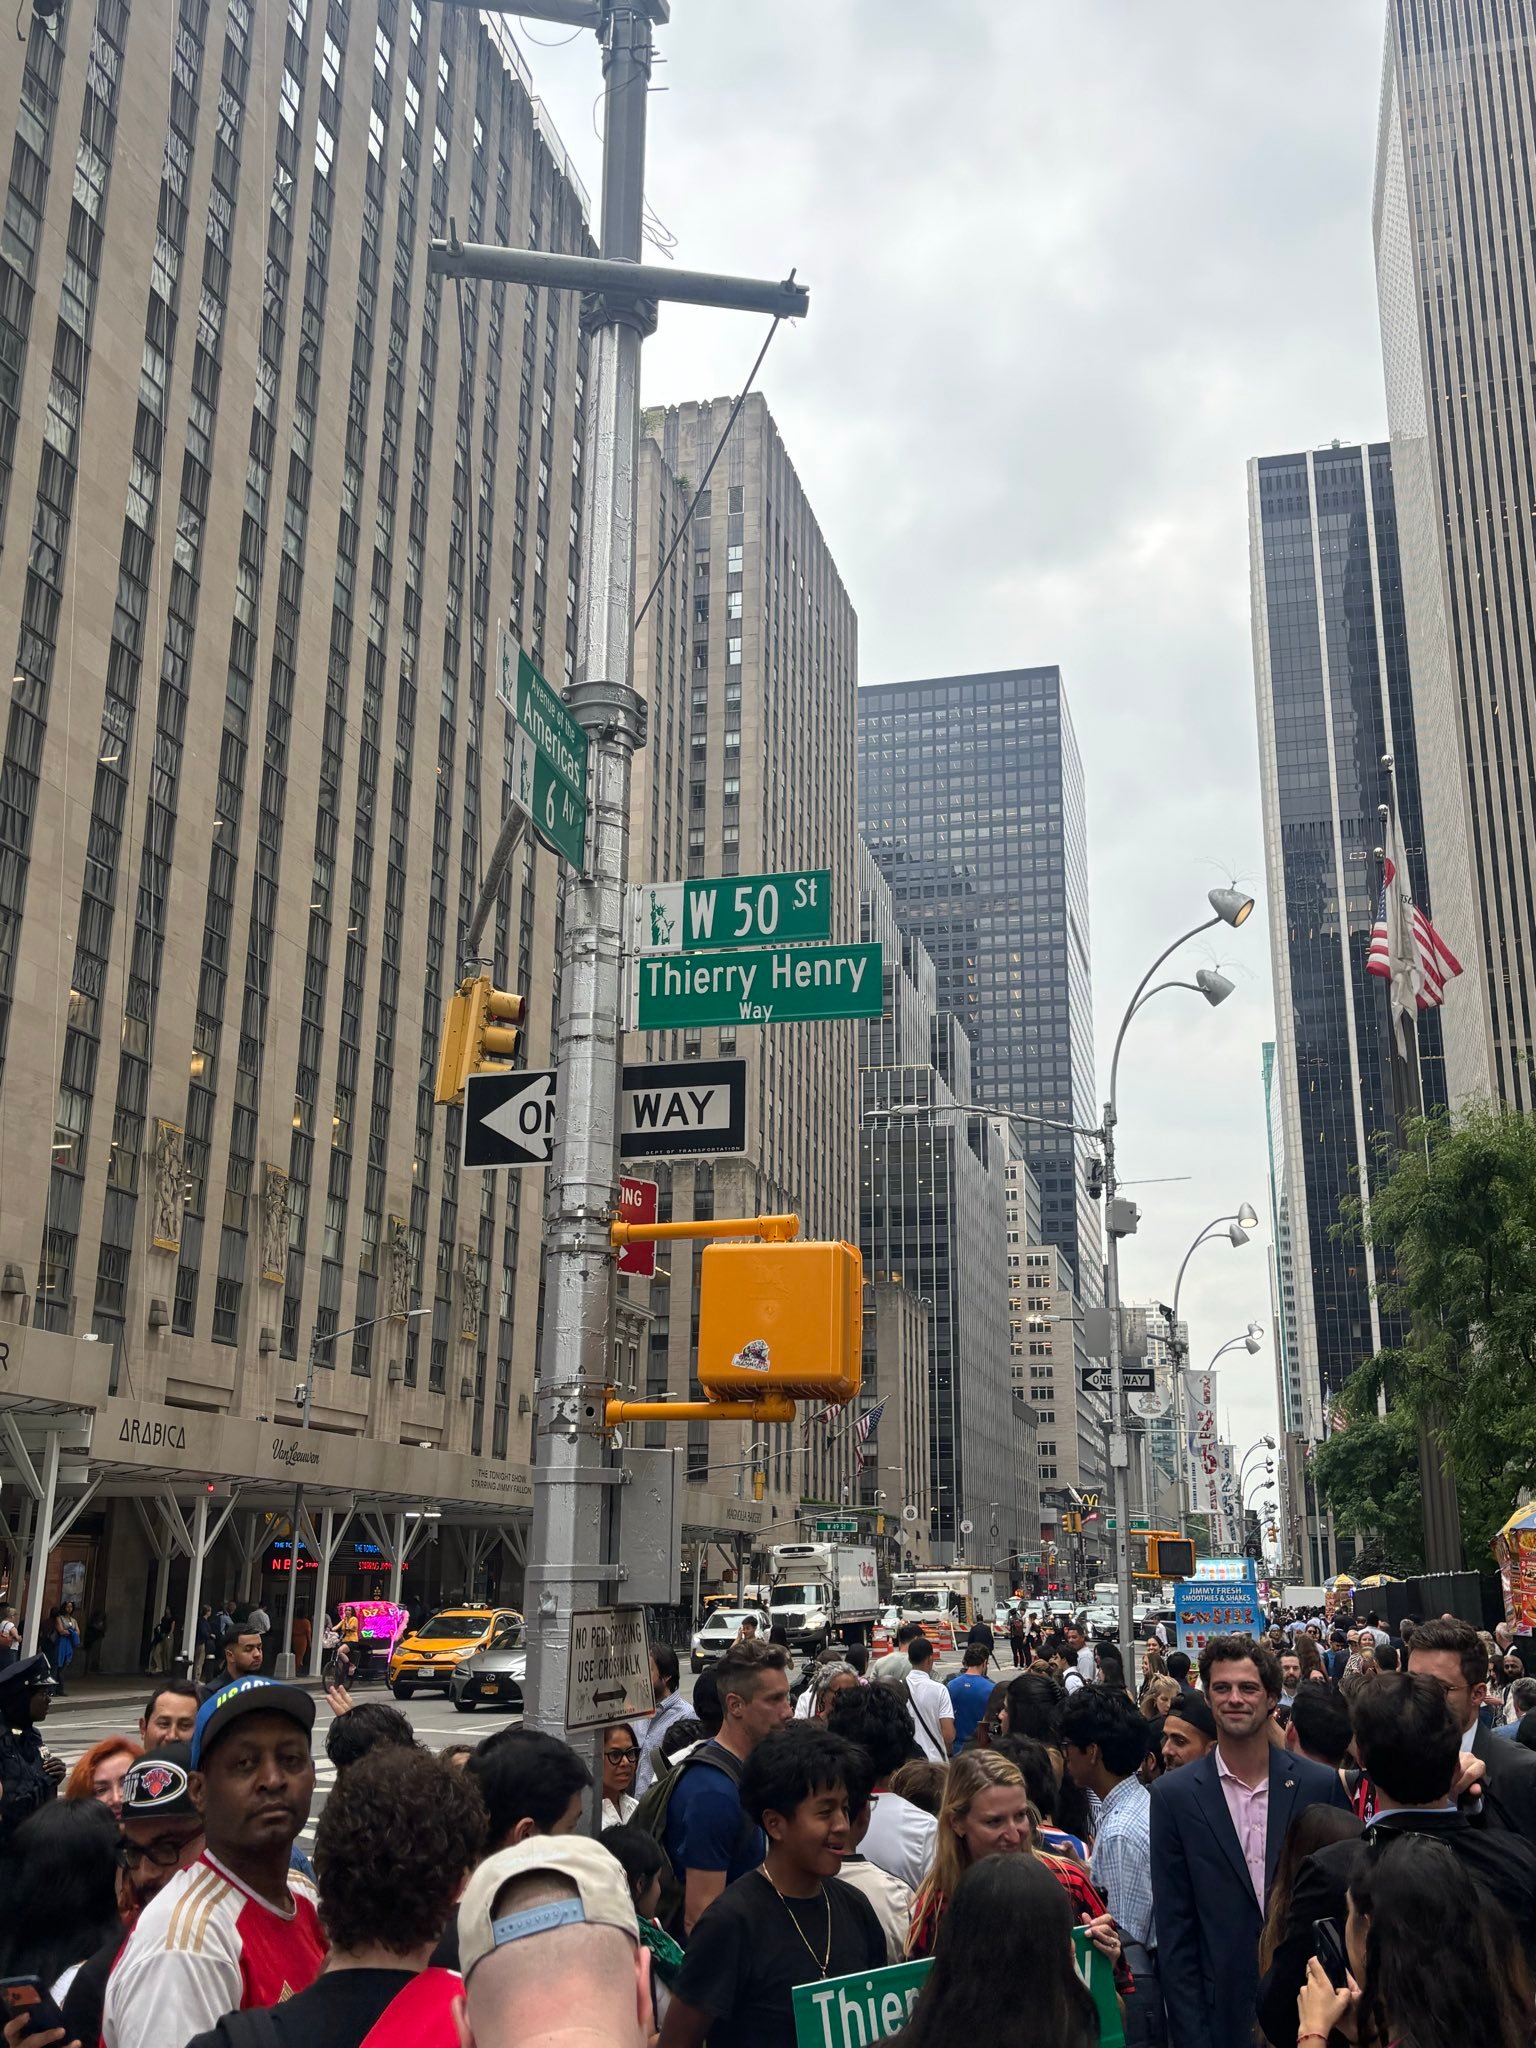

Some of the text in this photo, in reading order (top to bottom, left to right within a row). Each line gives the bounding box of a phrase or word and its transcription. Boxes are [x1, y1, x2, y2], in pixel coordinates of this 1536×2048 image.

[530, 674, 577, 744] Avenue of the
[523, 691, 581, 789] Americas
[545, 779, 575, 830] 6 Av
[689, 877, 818, 940] W 50 St
[646, 953, 868, 1000] Thierry Henry
[739, 1001, 774, 1023] Way
[518, 1090, 715, 1135] ON WAY
[1123, 1375, 1145, 1385] WAY
[118, 1417, 186, 1450] ARABICA
[478, 1468, 488, 1479] THE
[489, 1470, 511, 1481] TONIGHT
[1181, 1594, 1219, 1602] SMOOTHIES
[1188, 1586, 1242, 1595] JIMMY FRESH
[575, 1627, 587, 1650] NO
[610, 1622, 642, 1646] CROSSING
[577, 1654, 642, 1683] USE CROSSWALK
[811, 1980, 922, 2048] Thier
